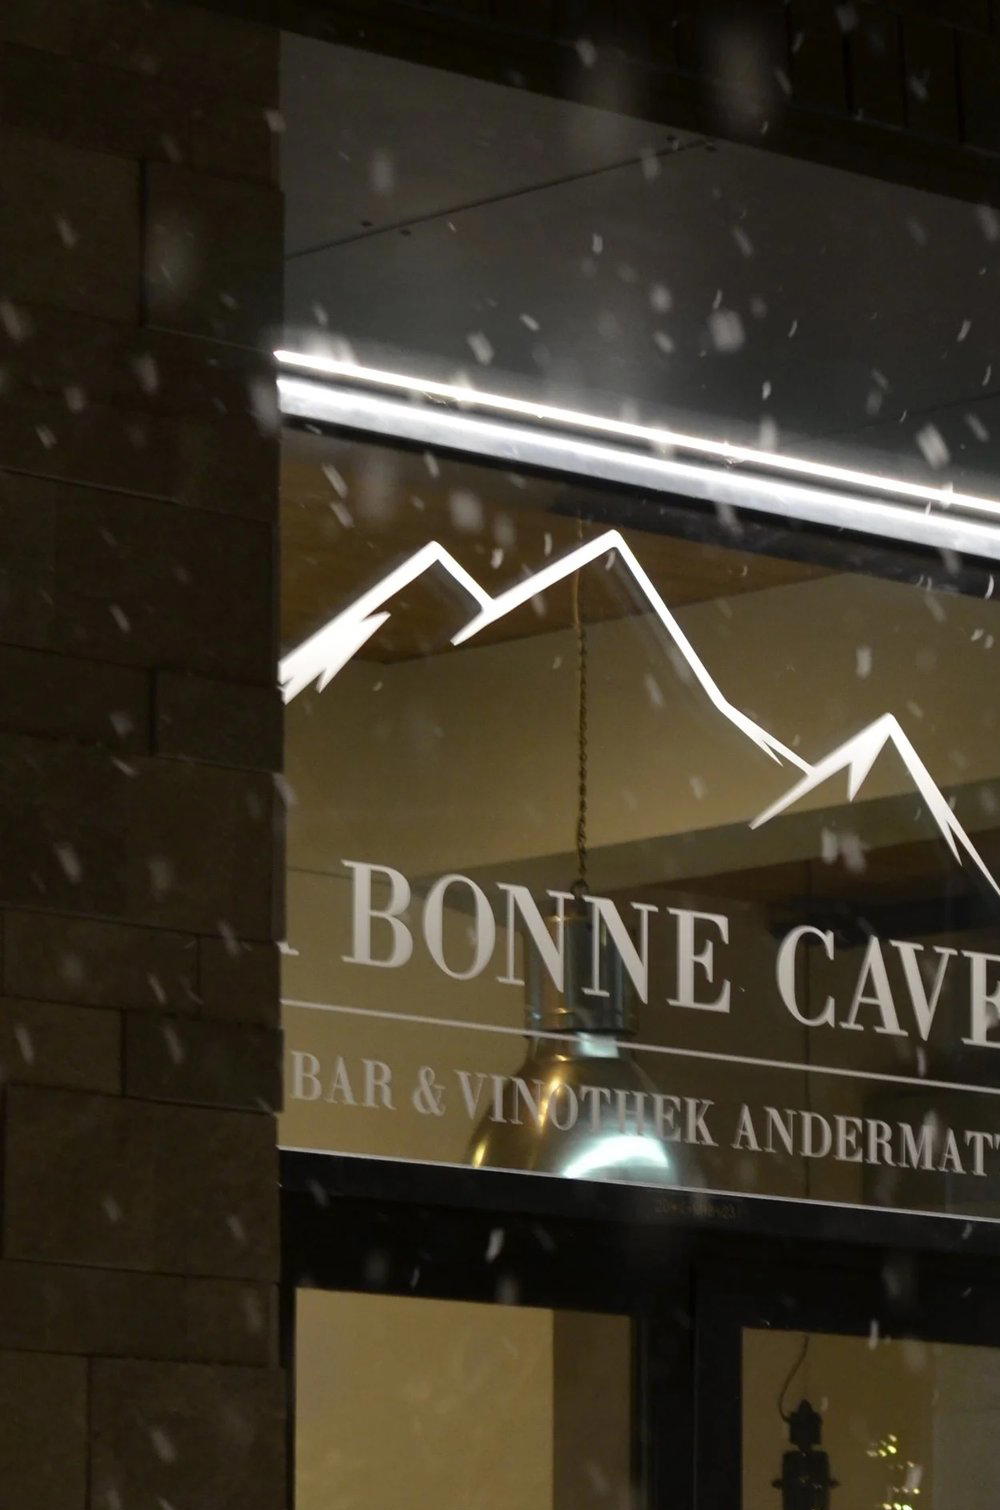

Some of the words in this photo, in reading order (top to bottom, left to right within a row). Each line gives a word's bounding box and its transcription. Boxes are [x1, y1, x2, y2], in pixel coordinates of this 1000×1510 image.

[340, 859, 730, 1013] BONNE
[291, 1051, 397, 1110] BAR
[412, 1066, 446, 1117] &
[454, 1069, 719, 1147] VINOTHEK
